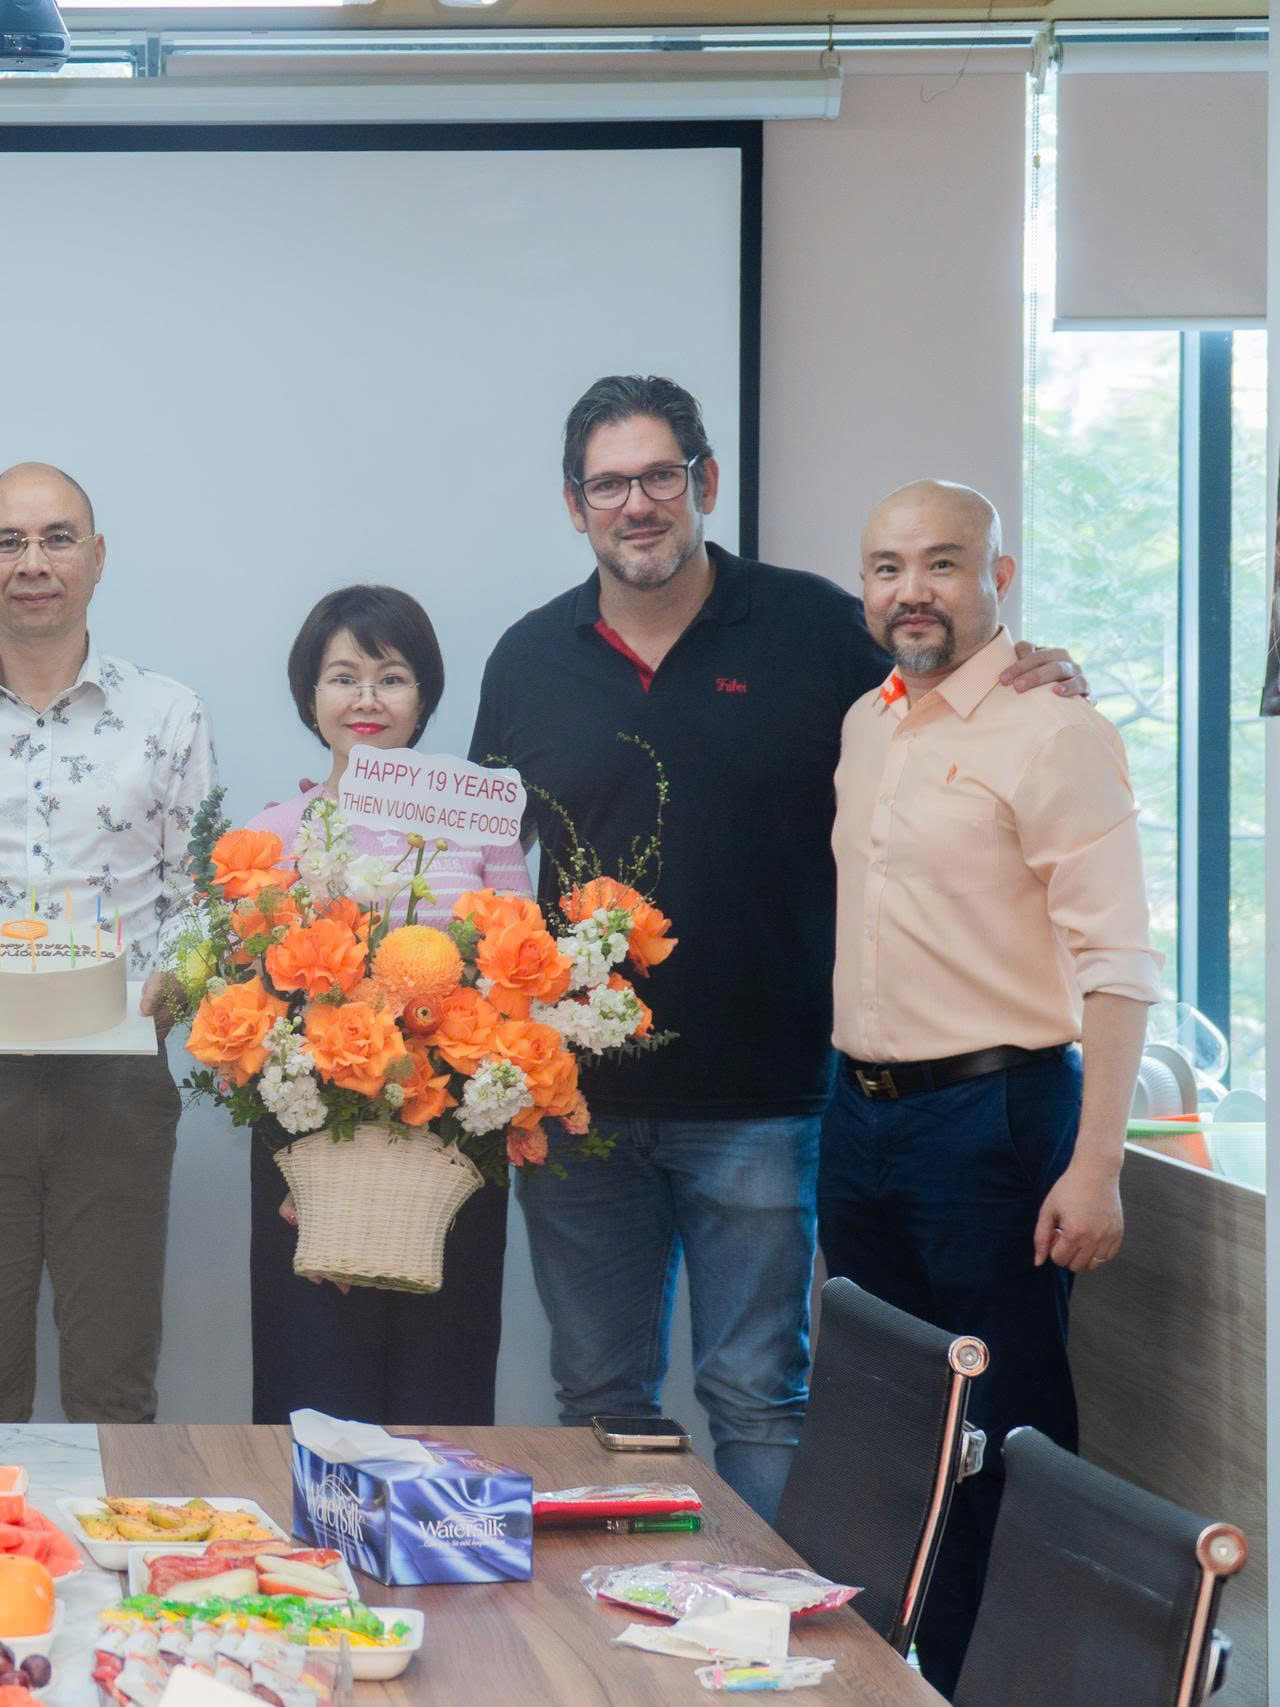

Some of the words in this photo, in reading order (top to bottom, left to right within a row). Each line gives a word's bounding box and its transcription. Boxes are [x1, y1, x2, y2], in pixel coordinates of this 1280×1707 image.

[354, 757, 422, 788] HAPPY
[426, 770, 448, 792] 19
[453, 773, 518, 804] YEARS
[343, 791, 383, 817] THIEN
[386, 799, 436, 824] VUONG
[436, 807, 468, 829] ACE
[469, 812, 519, 837] FOODS
[418, 1518, 507, 1539] Watersilk
